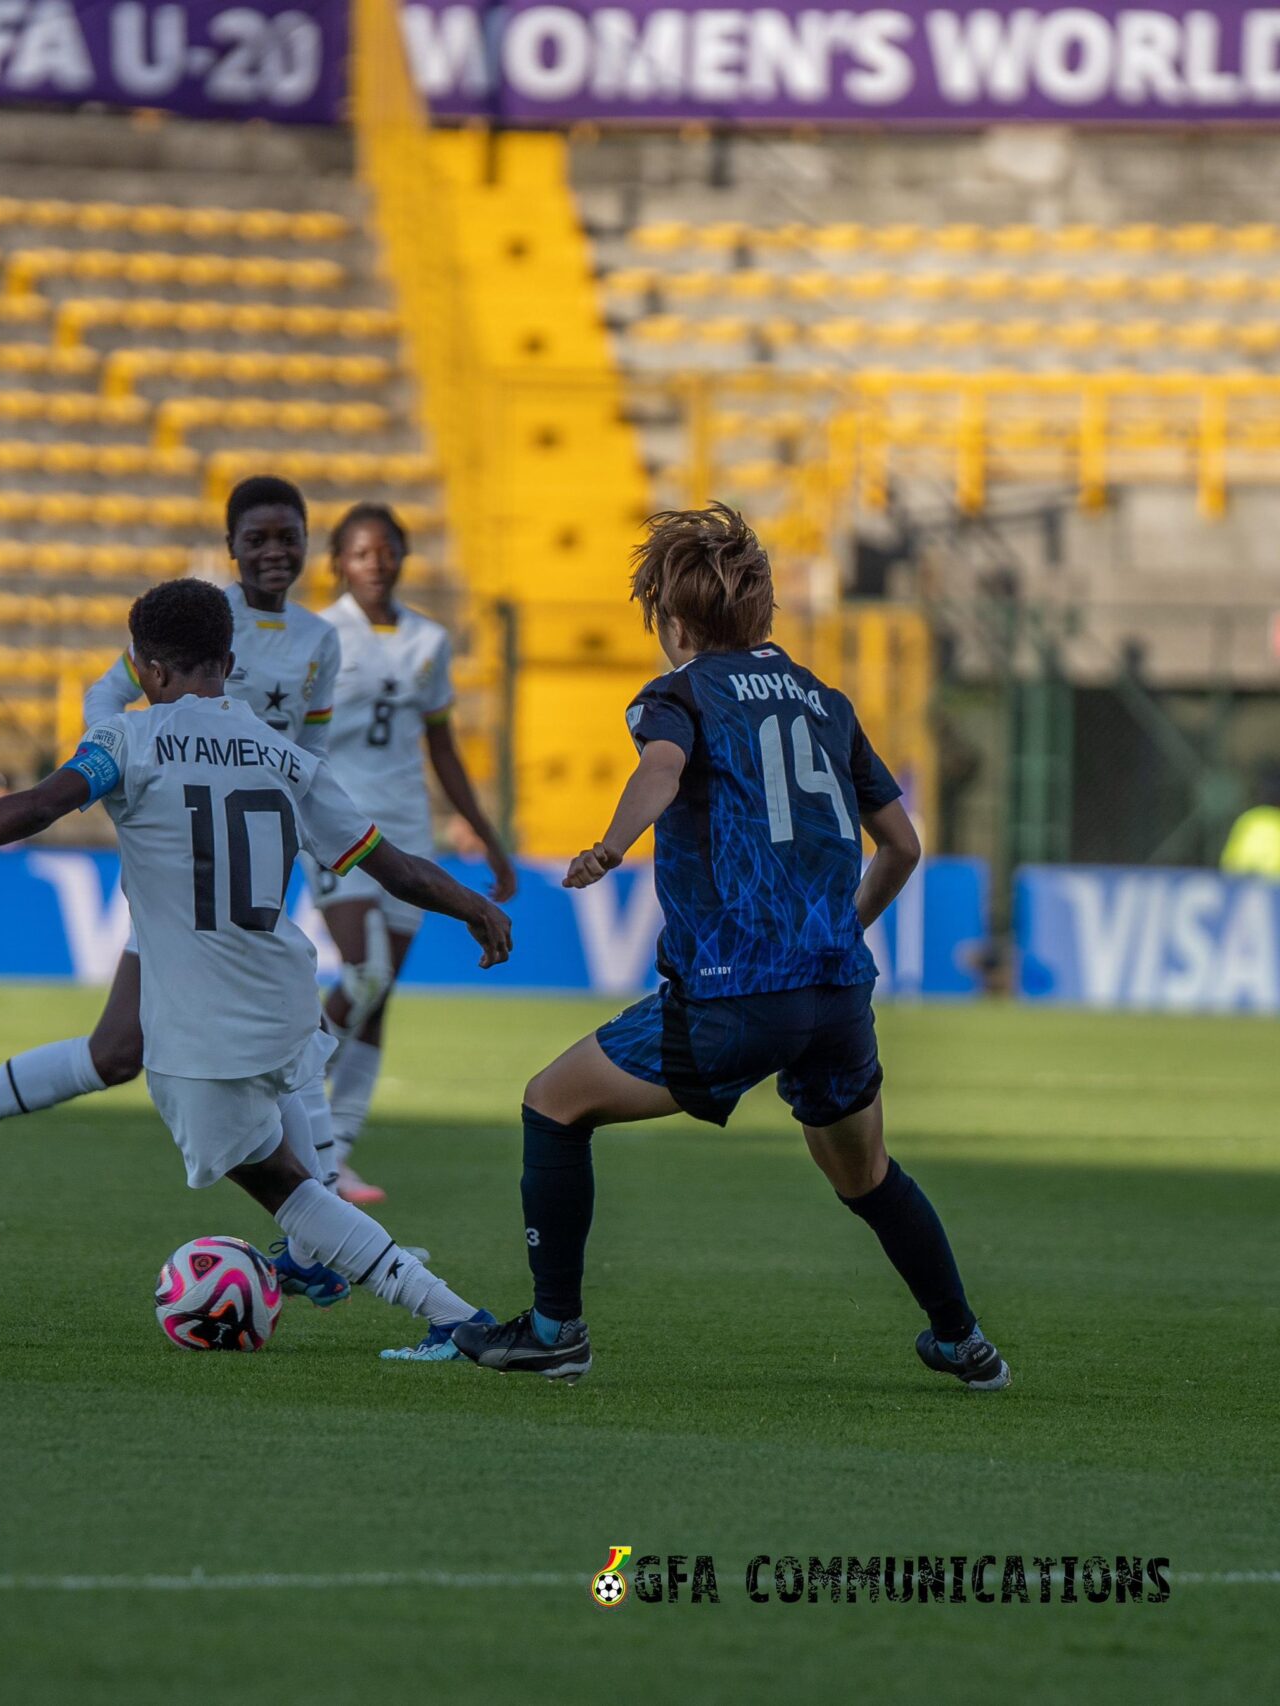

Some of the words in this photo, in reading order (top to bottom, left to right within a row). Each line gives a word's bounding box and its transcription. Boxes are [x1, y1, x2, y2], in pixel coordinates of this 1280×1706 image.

[109, 4, 321, 105] U-20
[402, 4, 915, 104] WOMEN'S
[366, 701, 395, 746] 8
[728, 672, 829, 718] KOYAA
[155, 734, 301, 784] NYAMEKYE
[758, 714, 856, 843] 14
[183, 784, 299, 932] 10
[1061, 872, 1280, 1004] VISA
